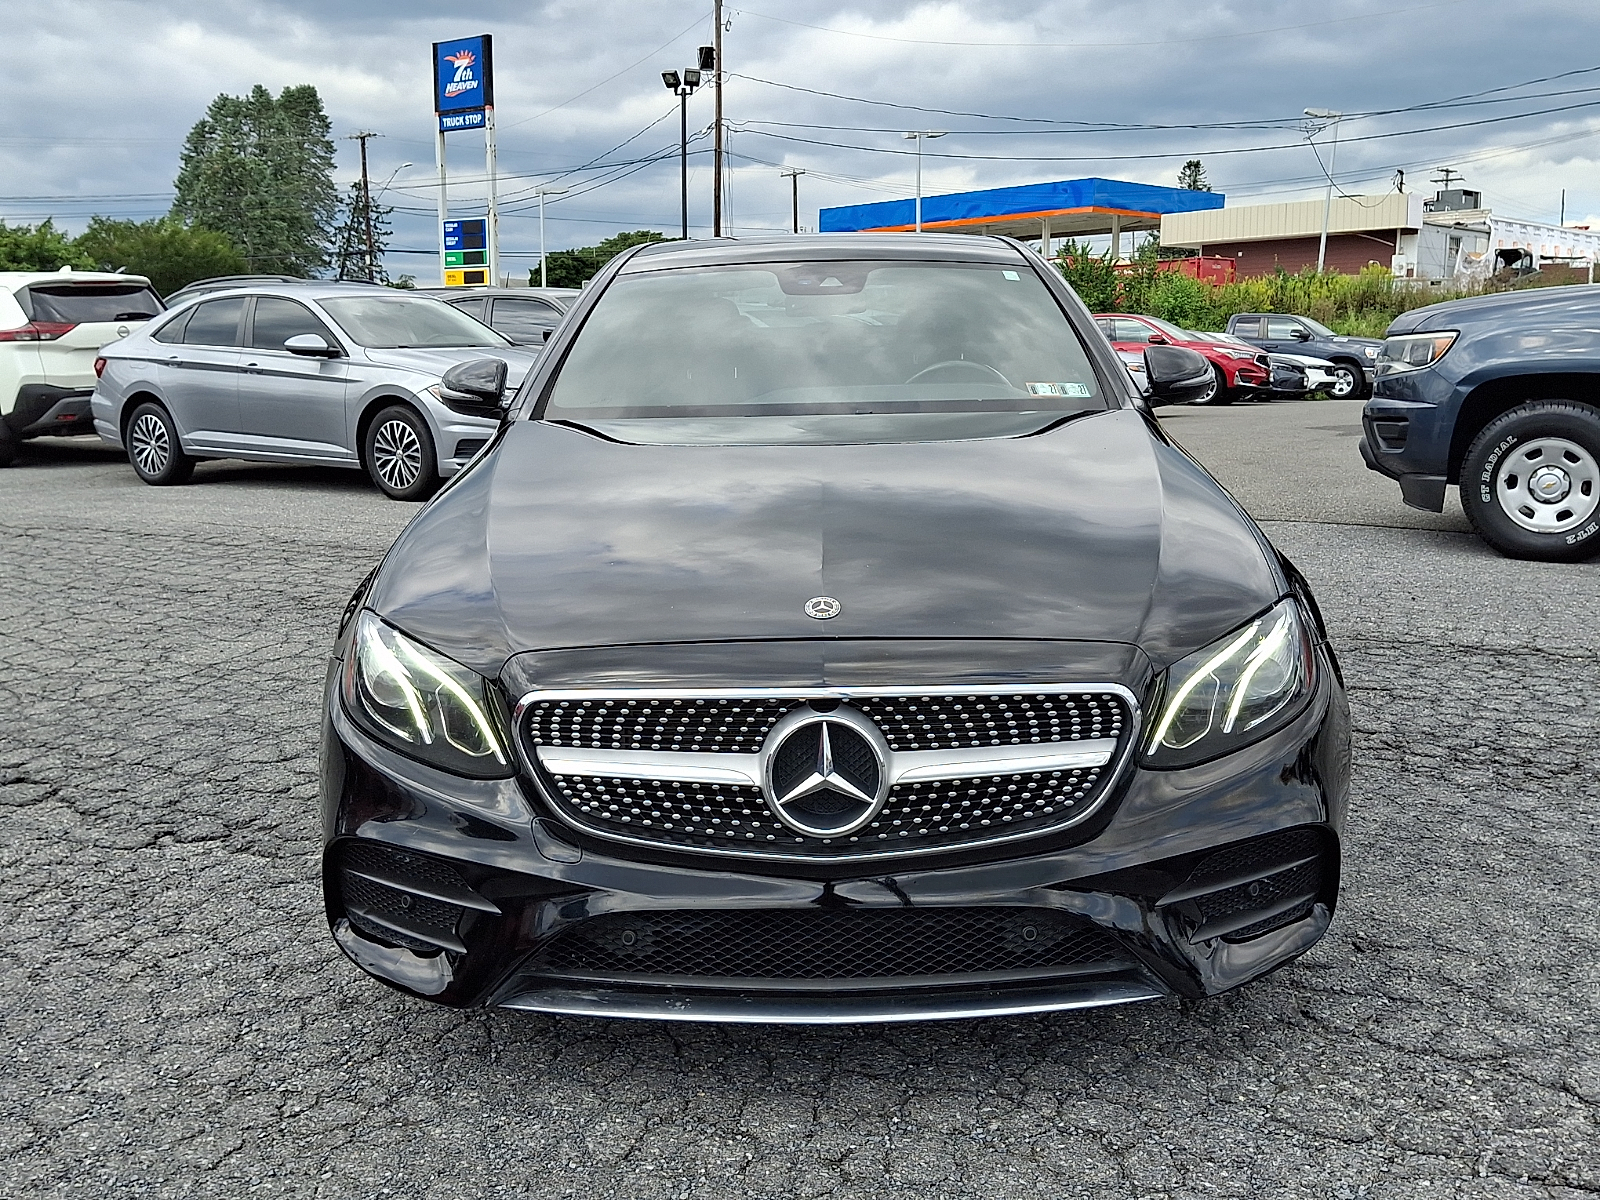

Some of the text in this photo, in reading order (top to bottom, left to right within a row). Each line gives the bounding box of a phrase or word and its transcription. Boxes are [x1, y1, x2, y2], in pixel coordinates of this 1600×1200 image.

[454, 59, 472, 82] 7th
[446, 80, 478, 93] HEAVEN
[442, 114, 482, 128] TRUCK STOP
[1480, 435, 1517, 503] GT RADIAL
[1565, 522, 1599, 545] HT2
